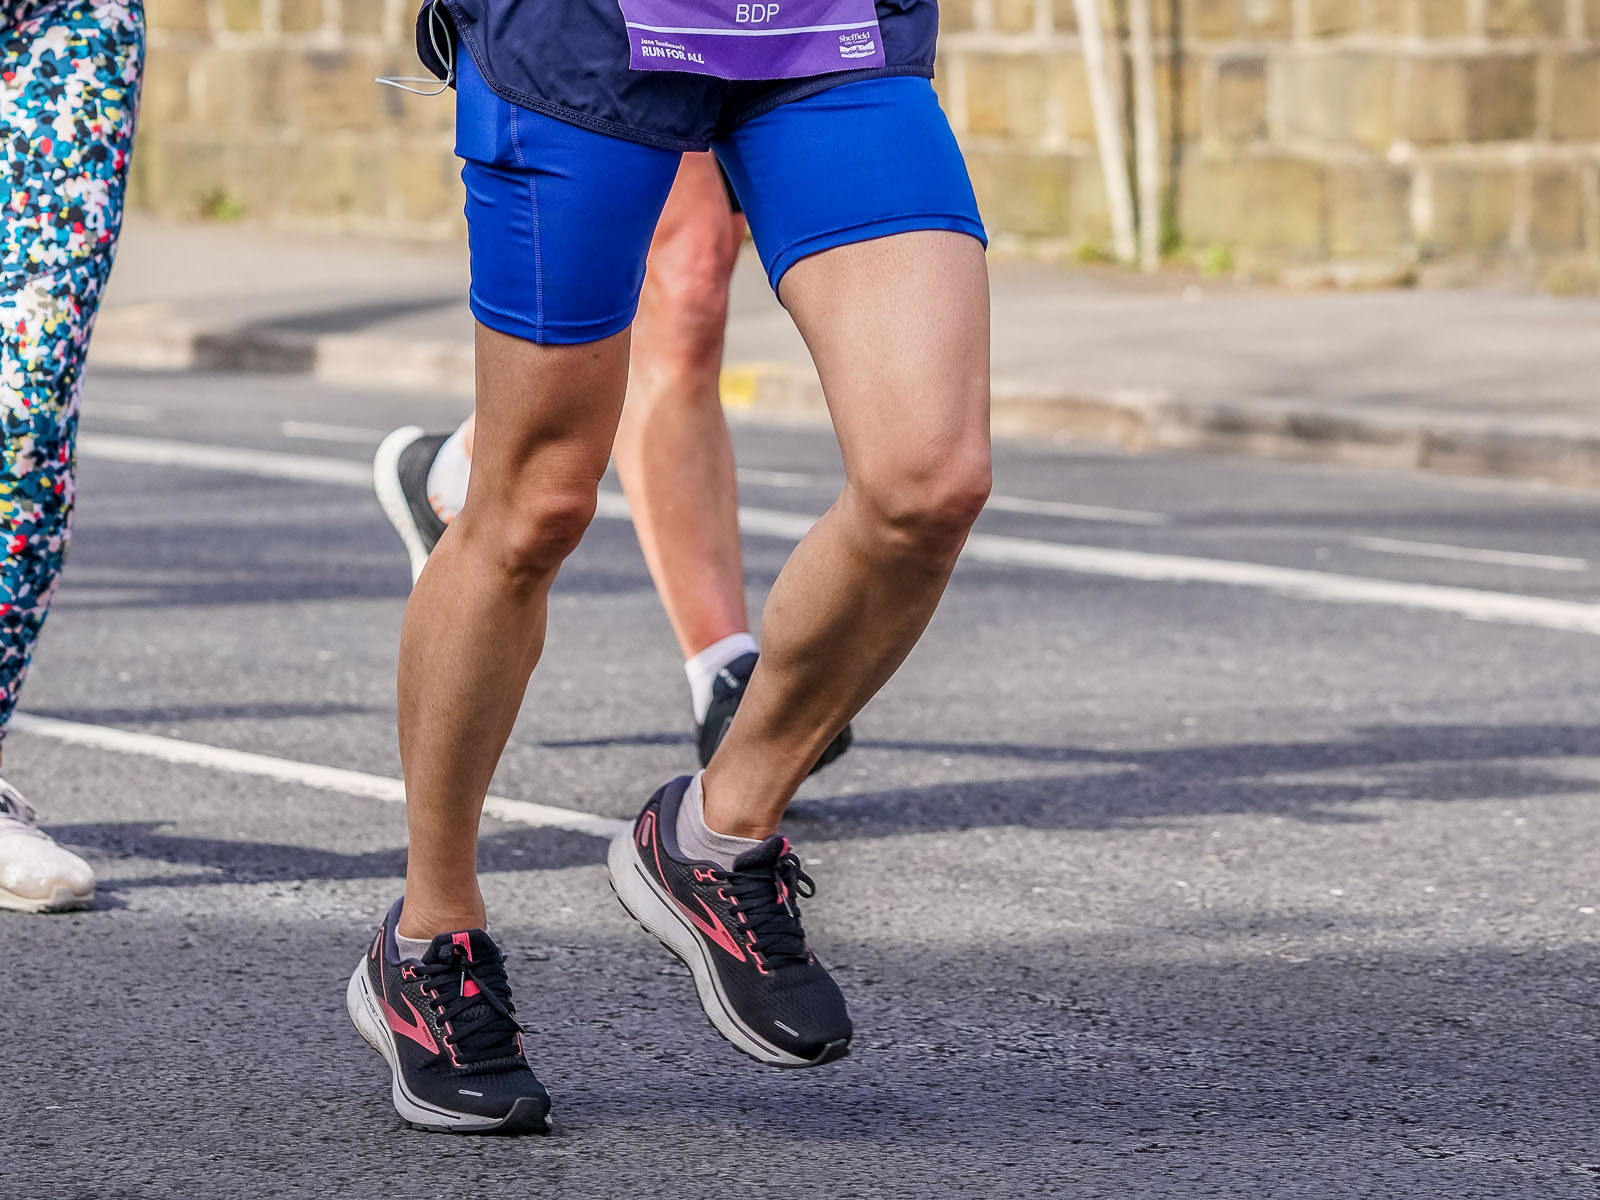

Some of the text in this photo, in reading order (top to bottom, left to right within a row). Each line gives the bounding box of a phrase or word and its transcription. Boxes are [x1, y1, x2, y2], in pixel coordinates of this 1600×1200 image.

[735, 3, 780, 23] BDP
[641, 45, 705, 64] RUN FOR ALL
